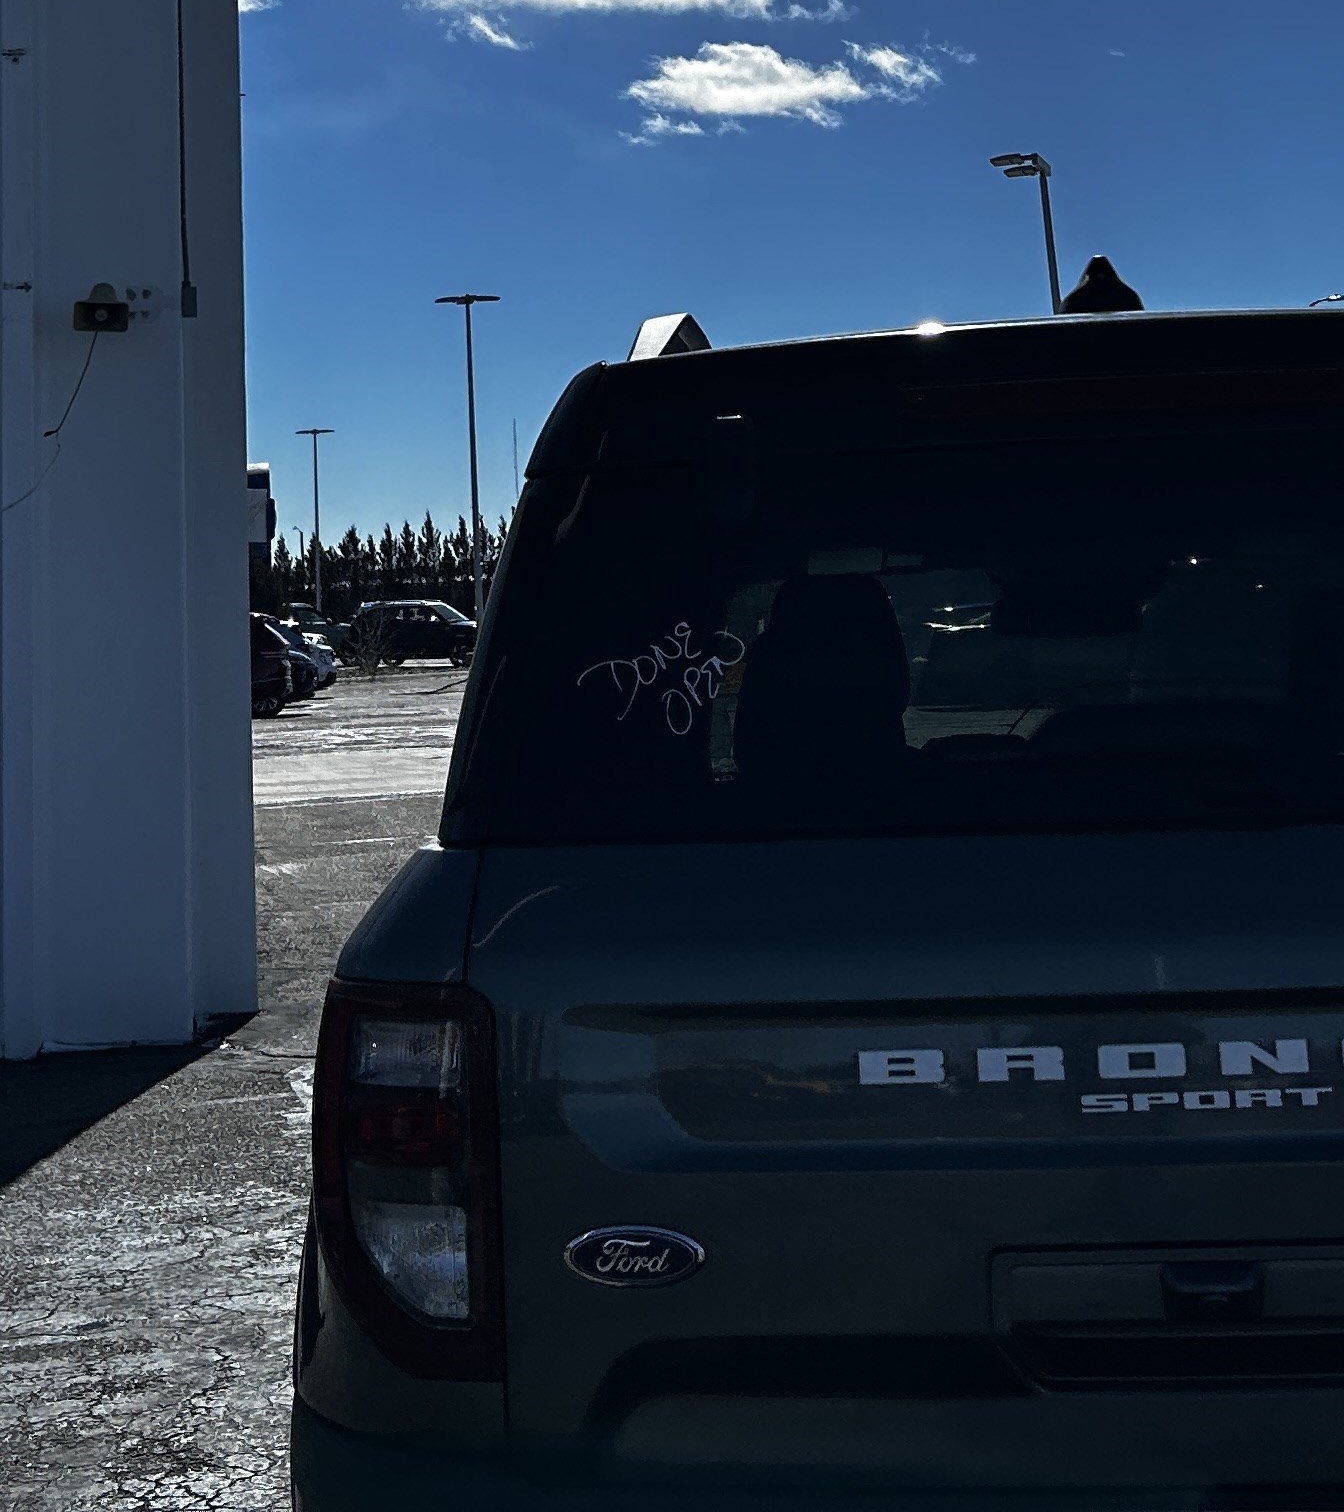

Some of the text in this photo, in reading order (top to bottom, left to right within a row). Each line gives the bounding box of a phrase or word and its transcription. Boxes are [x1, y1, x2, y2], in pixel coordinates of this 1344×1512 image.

[576, 621, 702, 721] DONE
[660, 628, 746, 735] OPEN
[1081, 1086, 1333, 1114] SPORT
[595, 1238, 671, 1273] Ford
